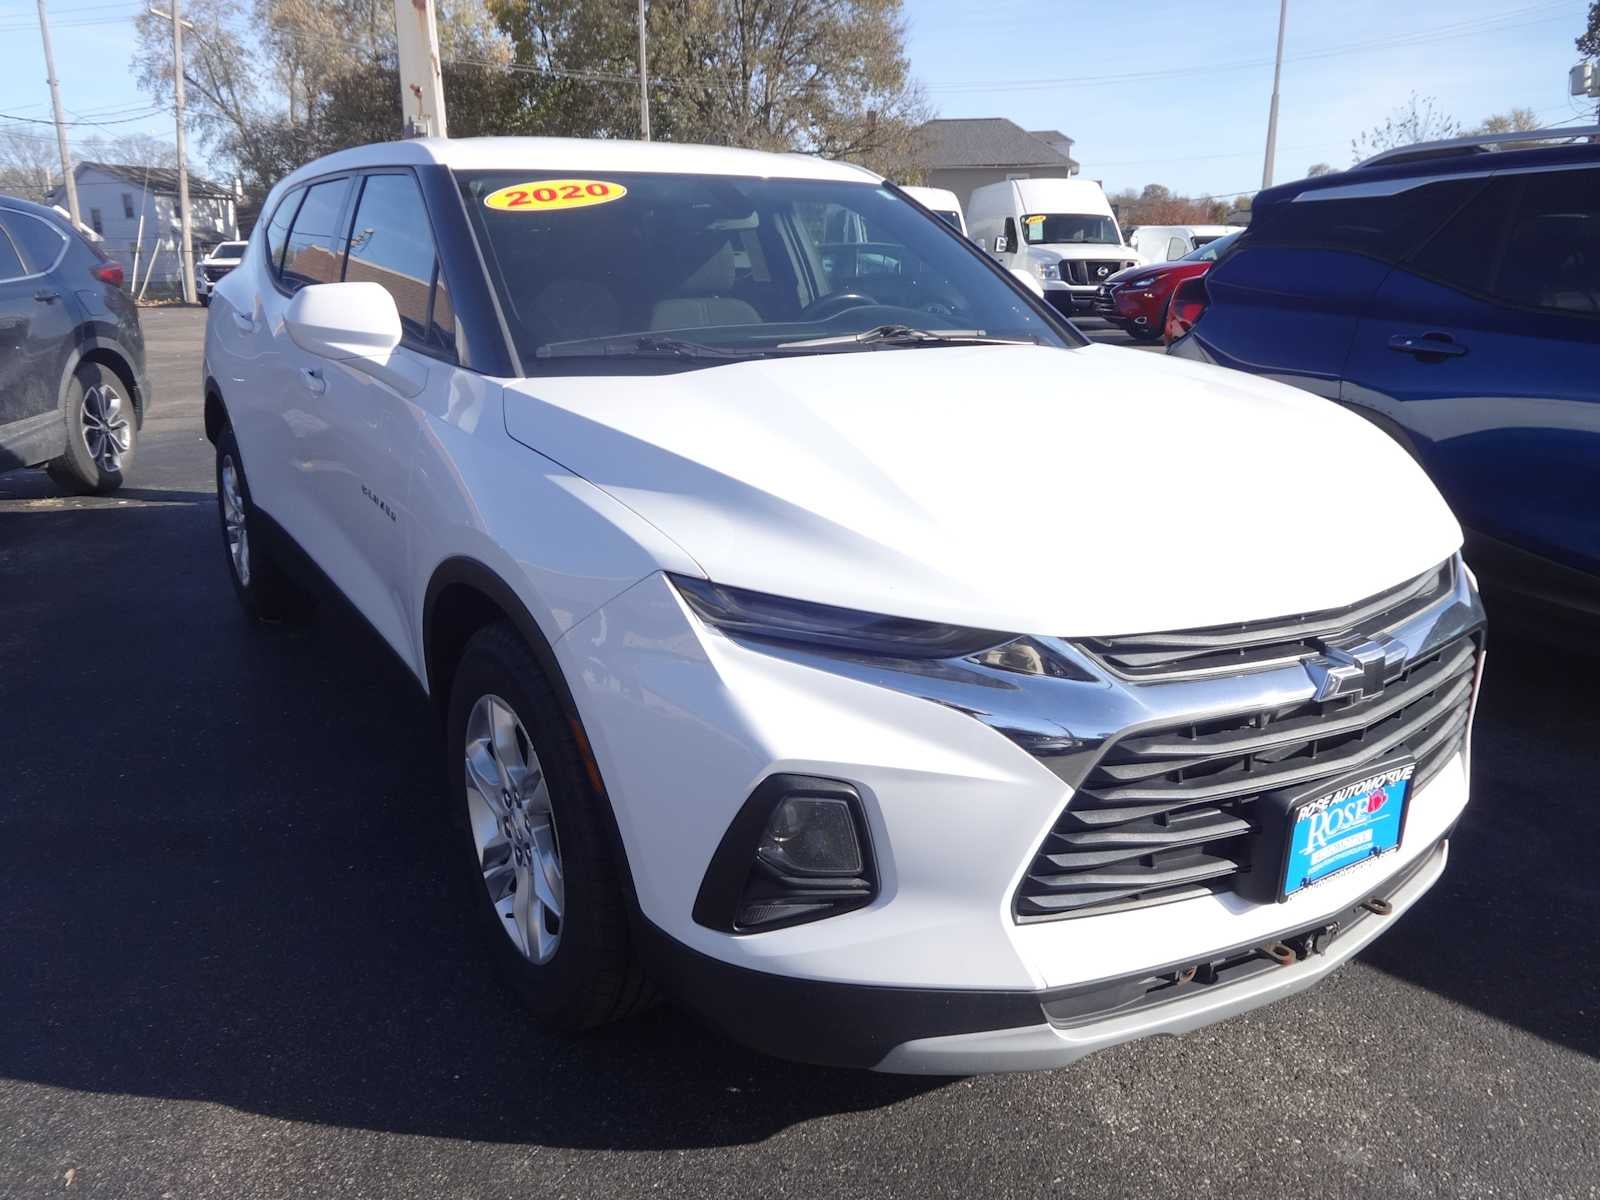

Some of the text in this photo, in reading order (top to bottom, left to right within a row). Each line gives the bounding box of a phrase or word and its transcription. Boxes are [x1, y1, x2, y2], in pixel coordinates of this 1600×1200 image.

[505, 183, 609, 207] 2020
[1297, 797, 1331, 823] ROSE
[1304, 797, 1369, 852] ROSE
